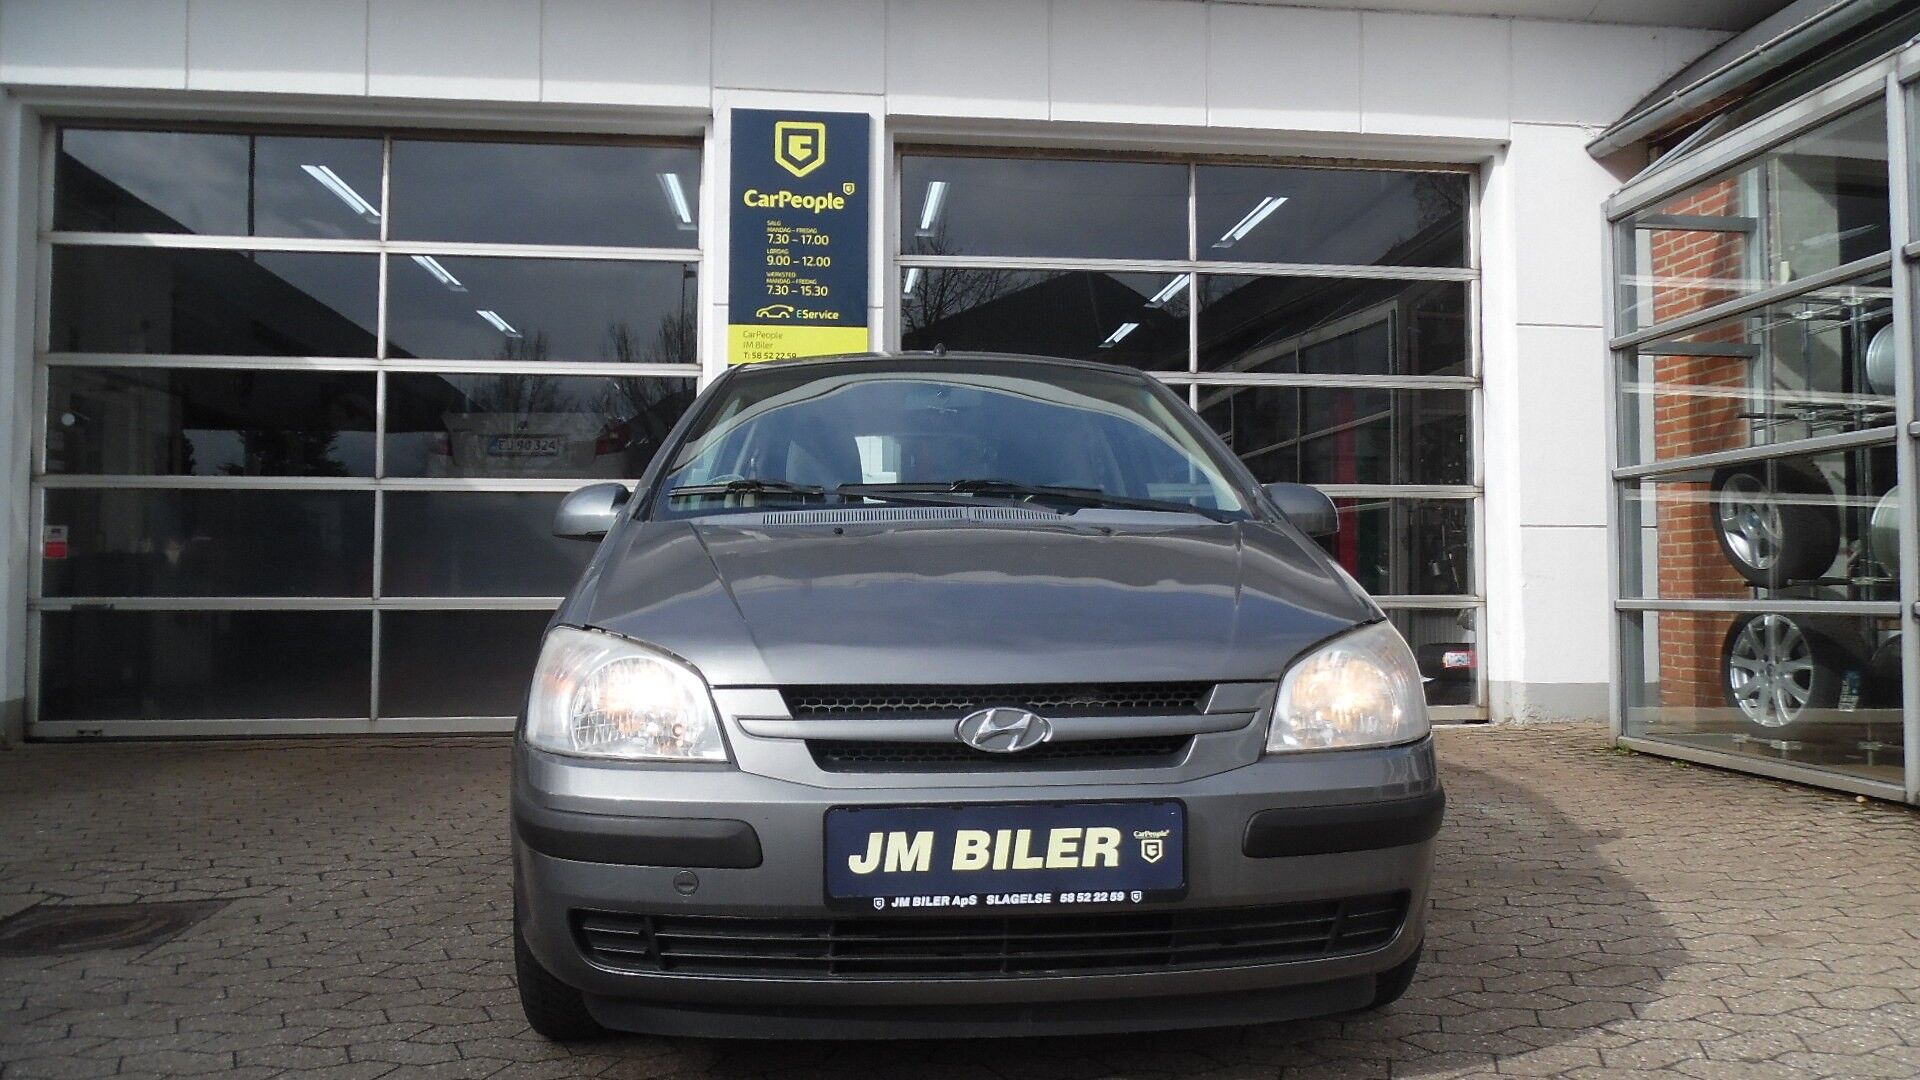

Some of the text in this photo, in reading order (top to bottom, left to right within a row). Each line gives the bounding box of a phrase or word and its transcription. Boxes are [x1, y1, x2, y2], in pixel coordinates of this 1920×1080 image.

[743, 189, 845, 214] CarPeople
[767, 234, 790, 245] 7.30
[801, 235, 829, 246] 17.00
[766, 256, 791, 266] 9.00
[802, 256, 831, 268] 12.00
[767, 286, 789, 296] 7.30
[800, 286, 828, 297] 15.30
[796, 309, 839, 320] EService
[743, 330, 783, 341] CarPeople
[755, 342, 774, 350] Biler
[744, 352, 750, 360] T:
[752, 352, 762, 360] 58
[1133, 830, 1168, 839] CarPeople
[848, 827, 1122, 874] JM BILER
[891, 896, 910, 908] JM
[912, 895, 950, 907] BILER
[952, 894, 977, 908] ApS
[986, 893, 1052, 905] SLAGELSE
[1076, 892, 1092, 903] 52
[1093, 891, 1108, 902] 22
[1109, 891, 1125, 902] 59
